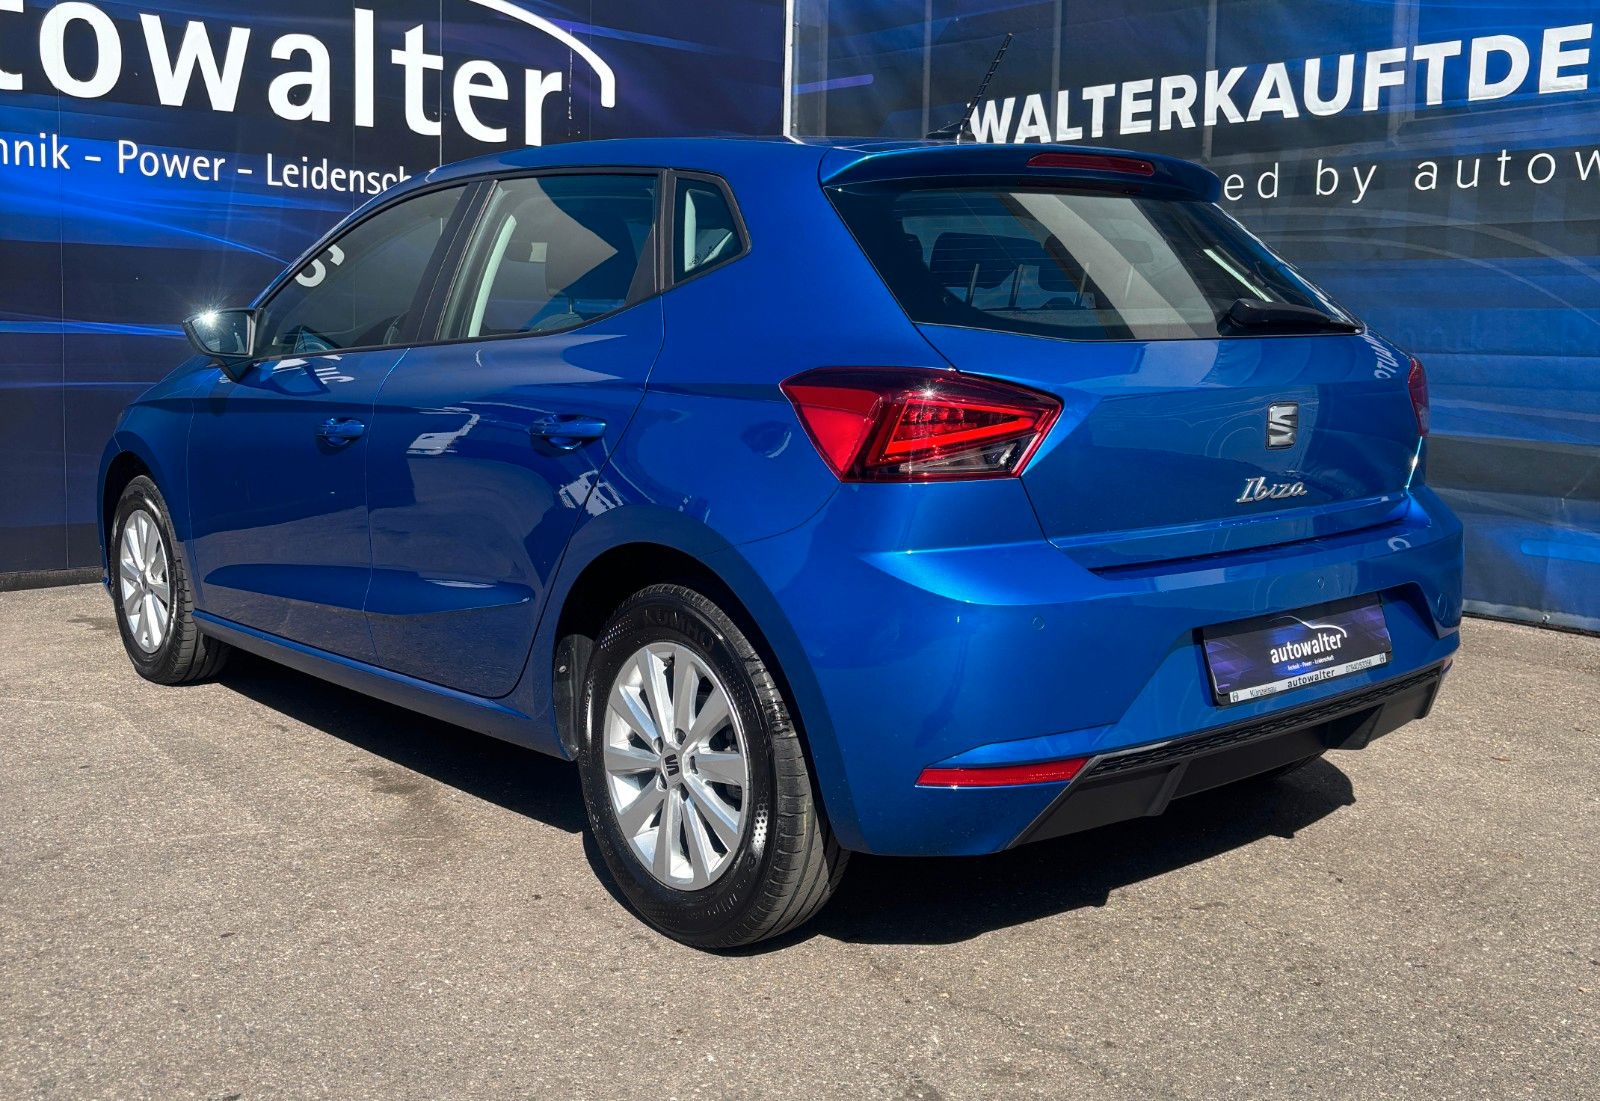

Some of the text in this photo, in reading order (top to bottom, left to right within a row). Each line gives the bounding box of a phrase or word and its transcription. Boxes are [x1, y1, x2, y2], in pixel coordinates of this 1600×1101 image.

[966, 23, 1593, 144] WALTERKAUFTDE
[118, 142, 225, 183] Power
[1223, 162, 1279, 201] ed
[1315, 159, 1377, 204] by
[1235, 476, 1308, 503] Ibiza
[1270, 632, 1342, 664] autowalter
[1287, 669, 1335, 688] autowalter
